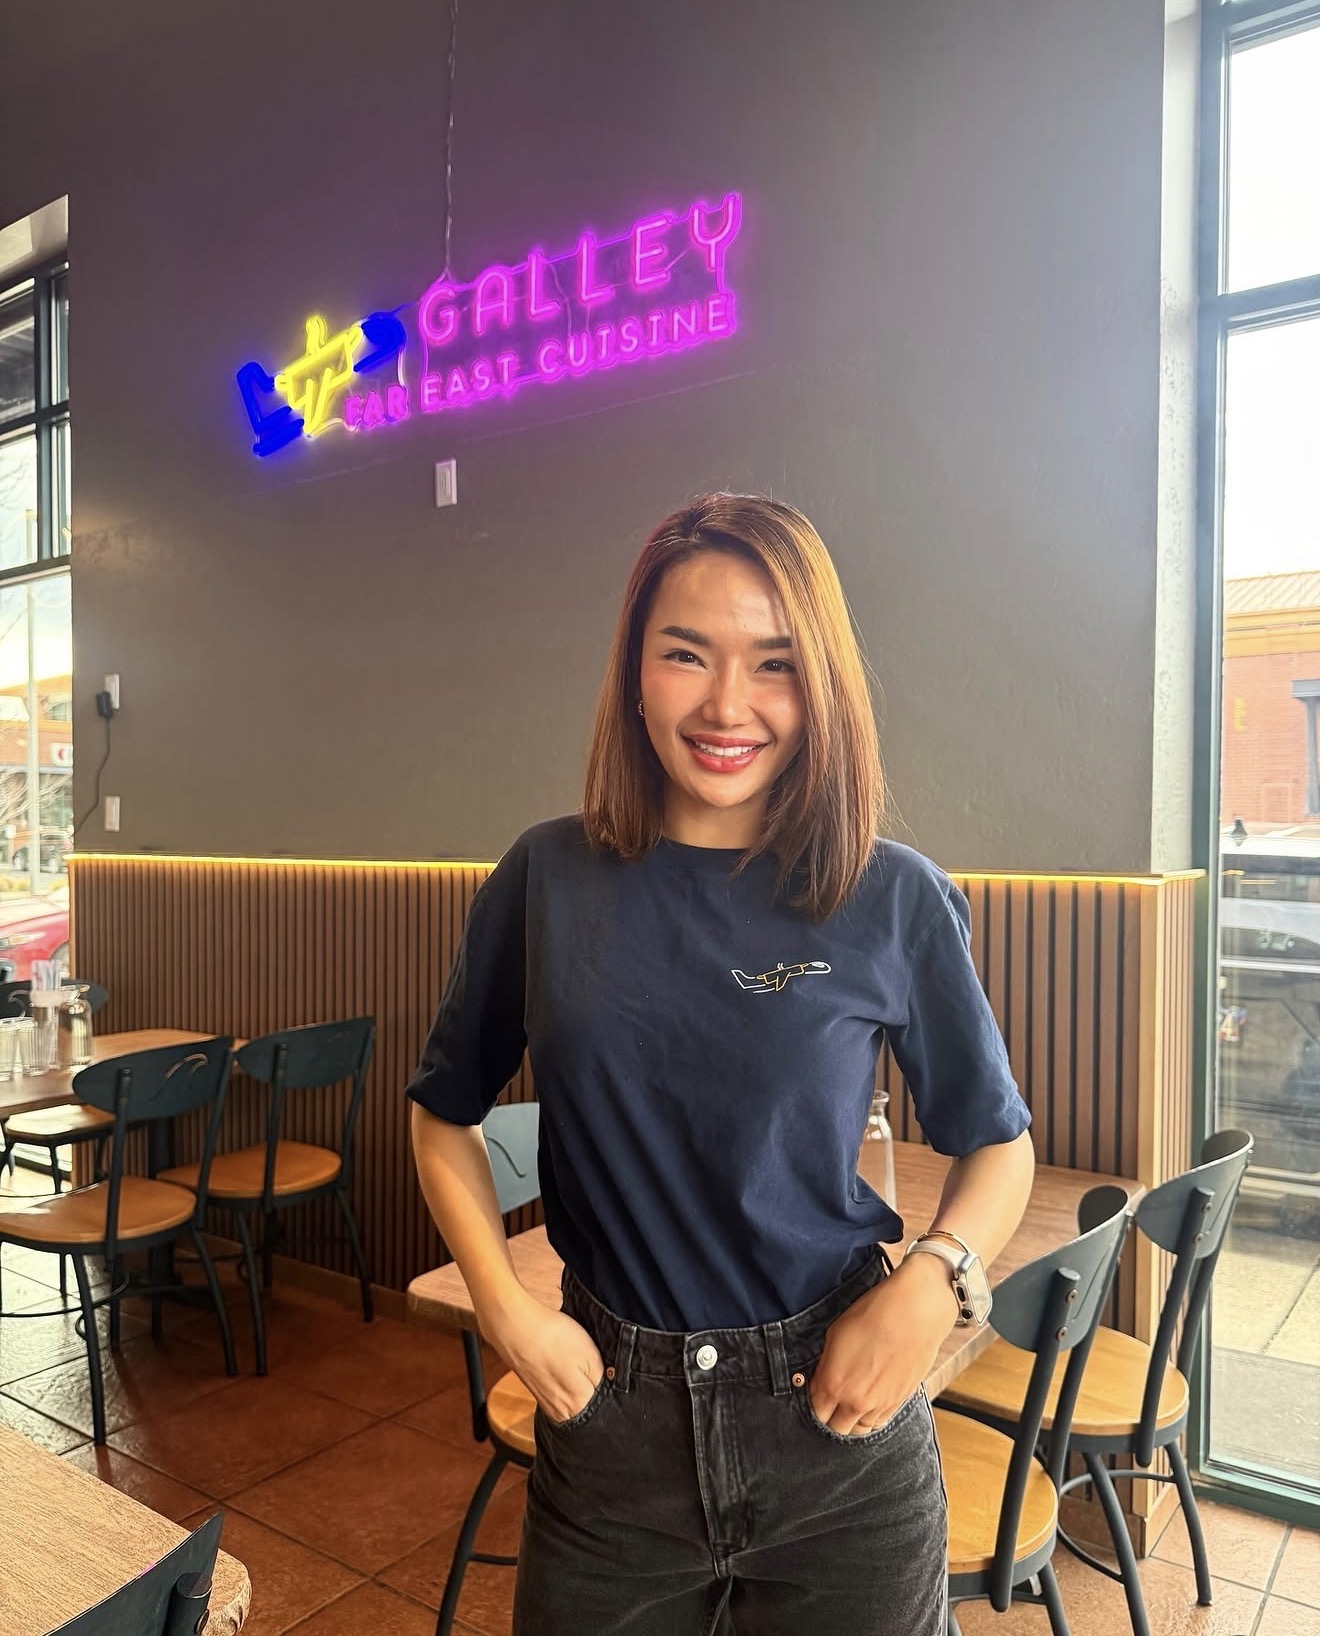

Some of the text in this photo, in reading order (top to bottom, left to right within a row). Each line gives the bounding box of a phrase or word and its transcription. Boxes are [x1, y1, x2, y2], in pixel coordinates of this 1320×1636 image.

[419, 194, 741, 344] GALLEY
[345, 297, 730, 427] FAR EAST CUISINE
